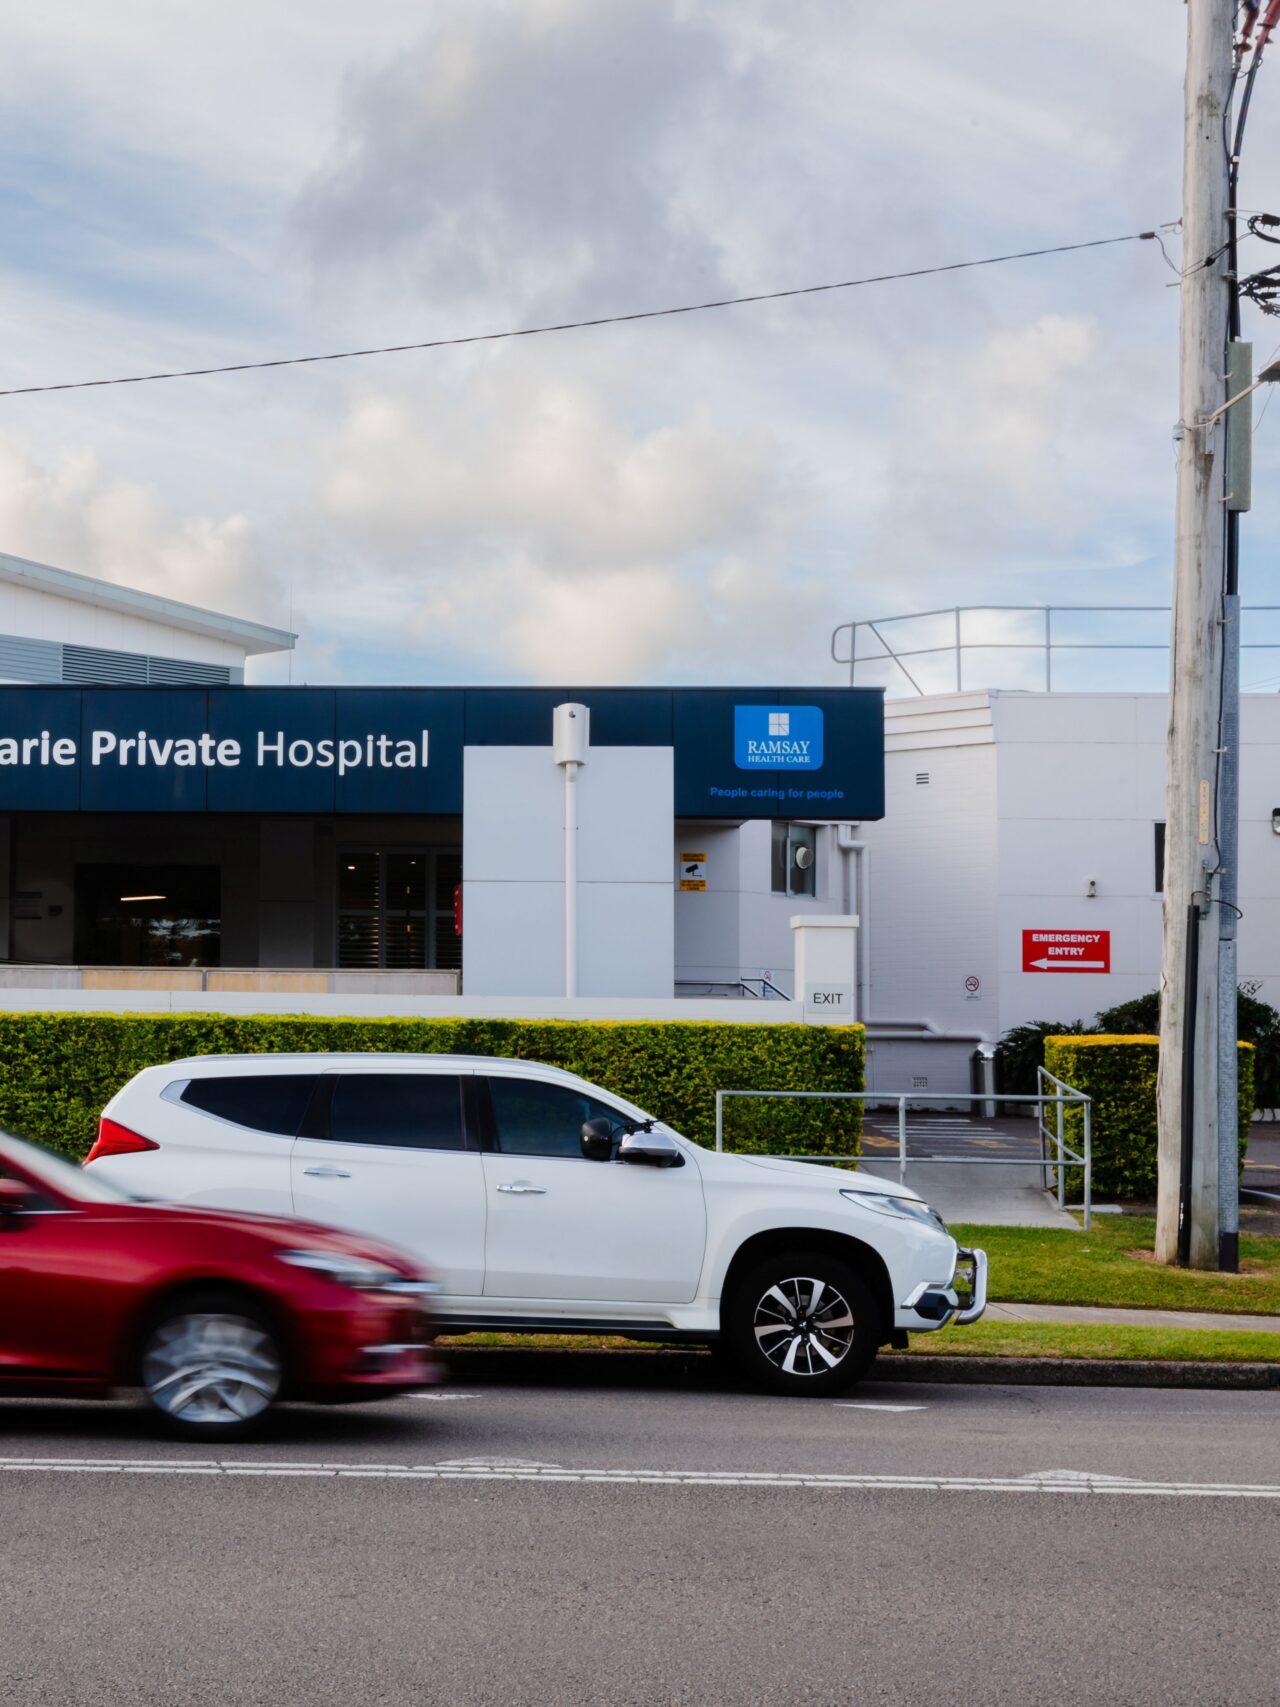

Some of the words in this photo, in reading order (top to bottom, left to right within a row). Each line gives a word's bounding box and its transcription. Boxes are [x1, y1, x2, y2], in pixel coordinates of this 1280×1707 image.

[91, 730, 241, 767] Private
[257, 729, 429, 776] Hospital
[747, 740, 811, 754] RAMSAY
[747, 755, 785, 763] HEALTH
[786, 755, 811, 763] CARE
[709, 786, 748, 799] People
[750, 788, 785, 800] caring
[788, 788, 804, 798] for
[806, 788, 845, 801] people
[1032, 933, 1101, 943] EMERGENCY
[1047, 946, 1085, 956] ENTRY
[813, 992, 844, 1004] EXIT
